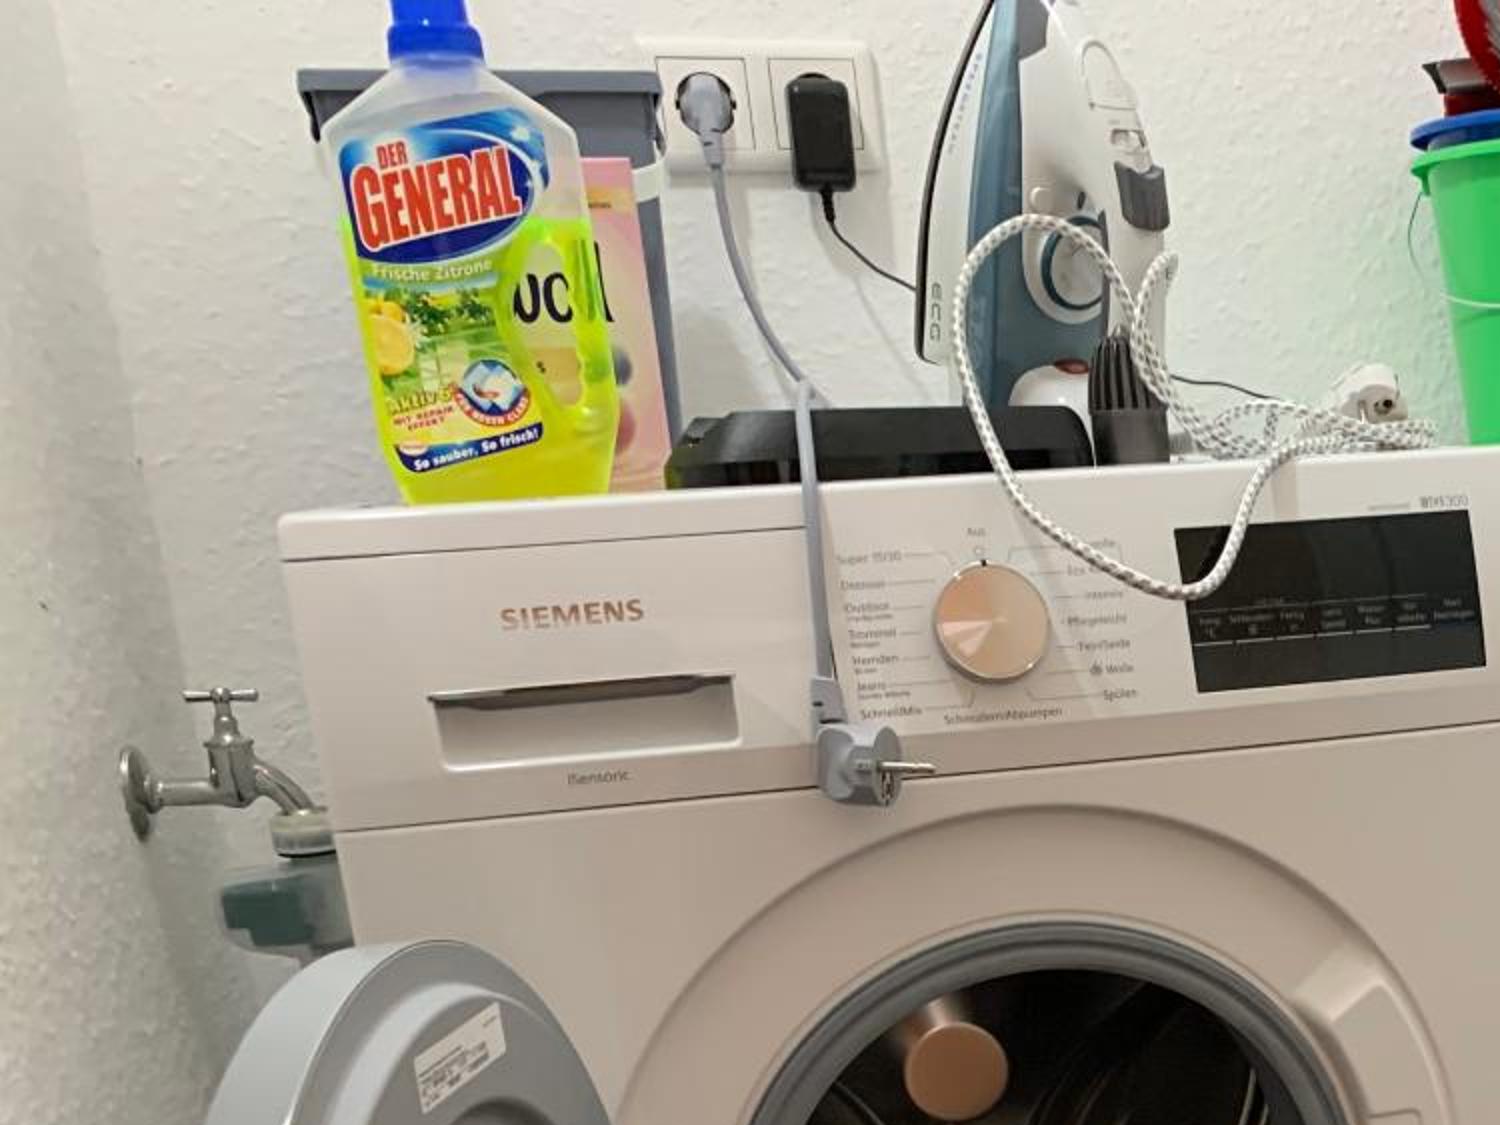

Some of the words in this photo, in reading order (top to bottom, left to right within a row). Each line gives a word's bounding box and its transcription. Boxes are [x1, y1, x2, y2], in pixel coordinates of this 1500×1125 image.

[376, 140, 408, 169] DER
[352, 144, 523, 251] GENERAL
[434, 256, 493, 280] Zitrone
[414, 459, 431, 472] So
[433, 446, 480, 467] sauber,
[481, 440, 498, 454] So
[499, 427, 539, 448] frisch!
[500, 599, 645, 631] SIEMENS
